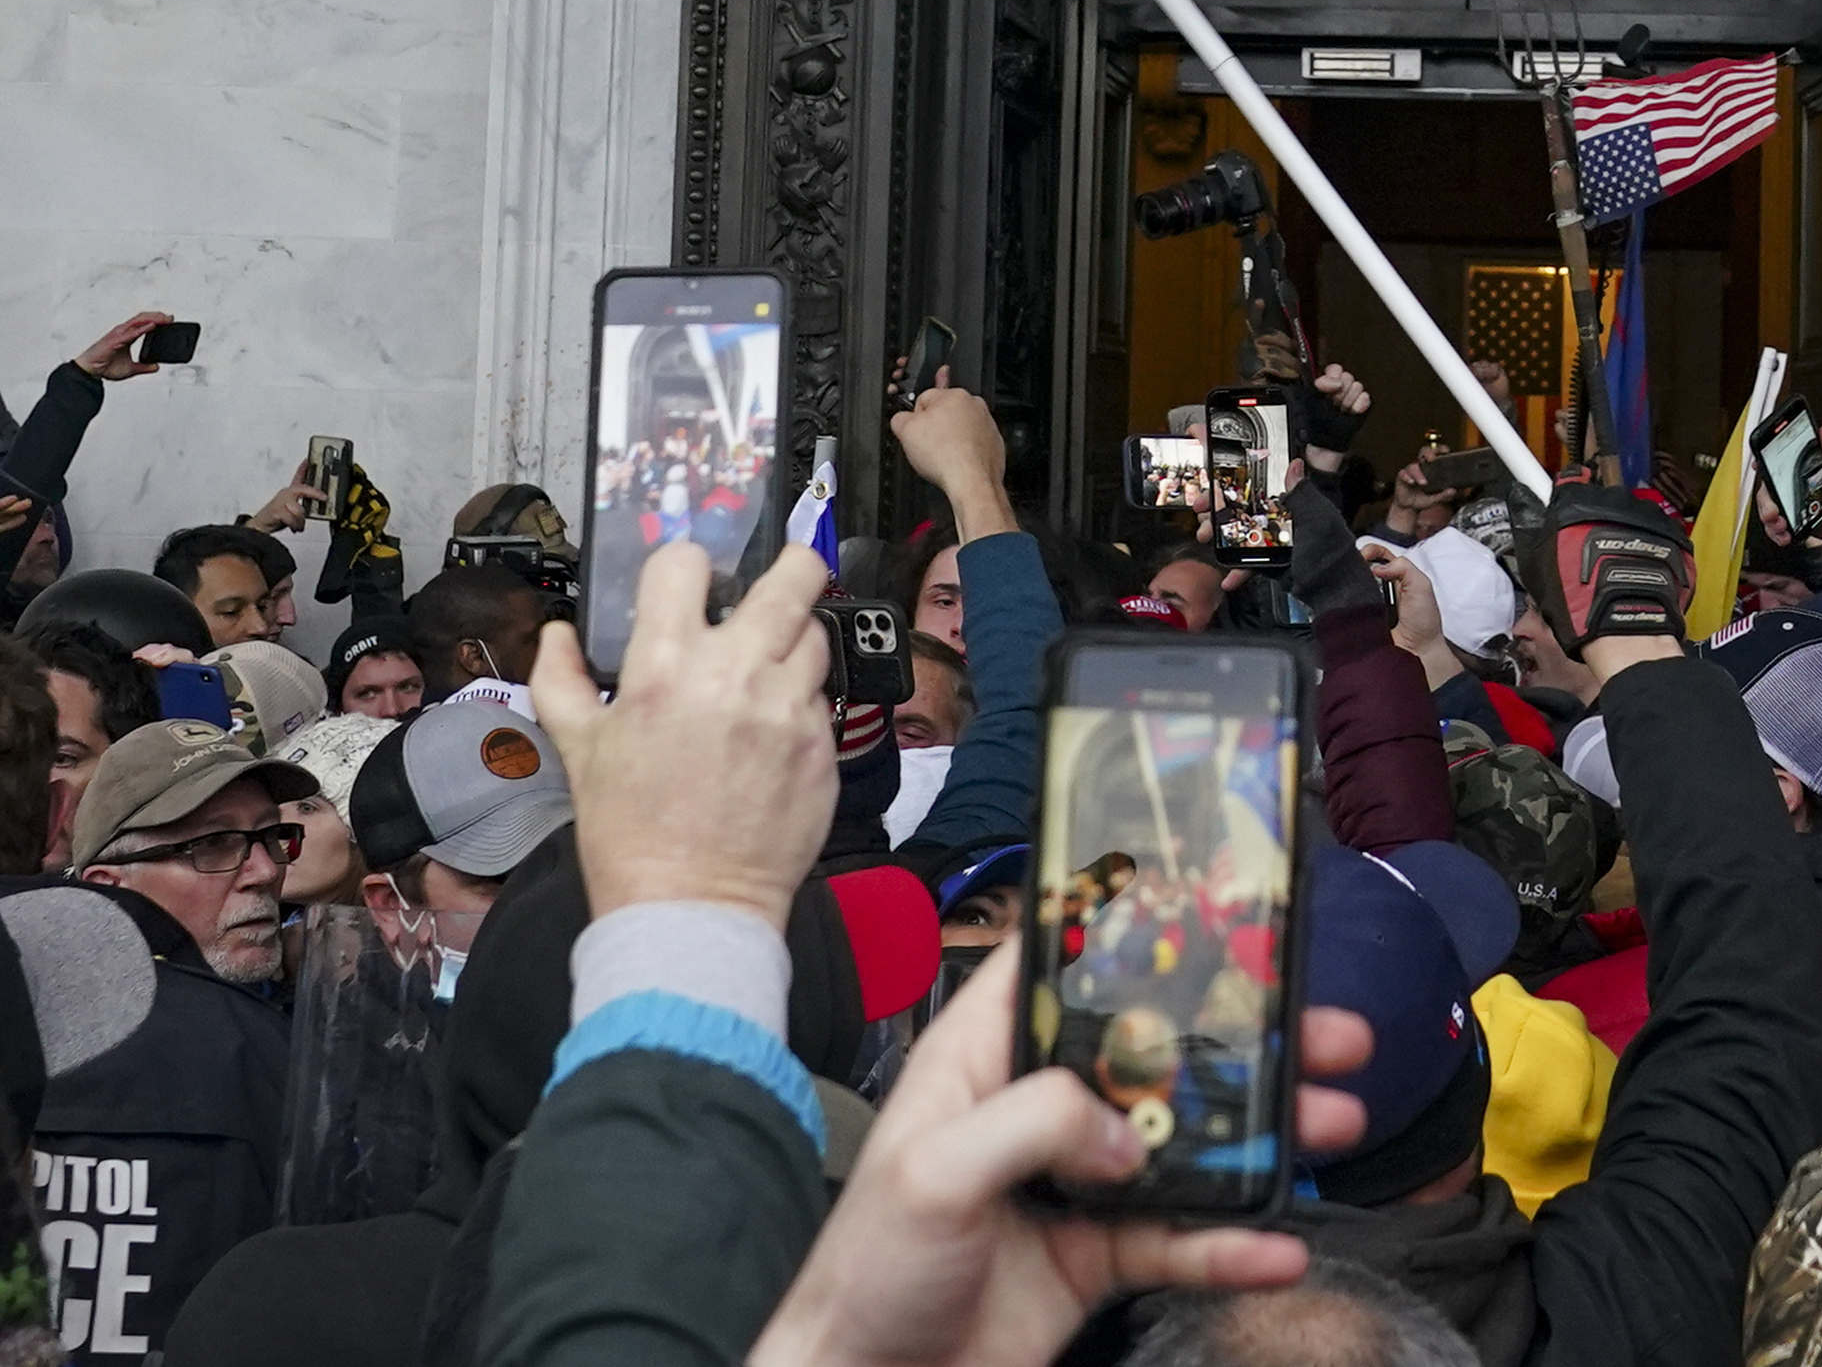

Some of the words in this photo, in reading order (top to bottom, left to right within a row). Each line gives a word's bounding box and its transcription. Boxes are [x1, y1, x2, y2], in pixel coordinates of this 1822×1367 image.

[343, 635, 379, 663] ORBIT
[1517, 881, 1558, 901] U.S.A
[31, 1148, 158, 1217] PITOL
[40, 1219, 158, 1353] CE
